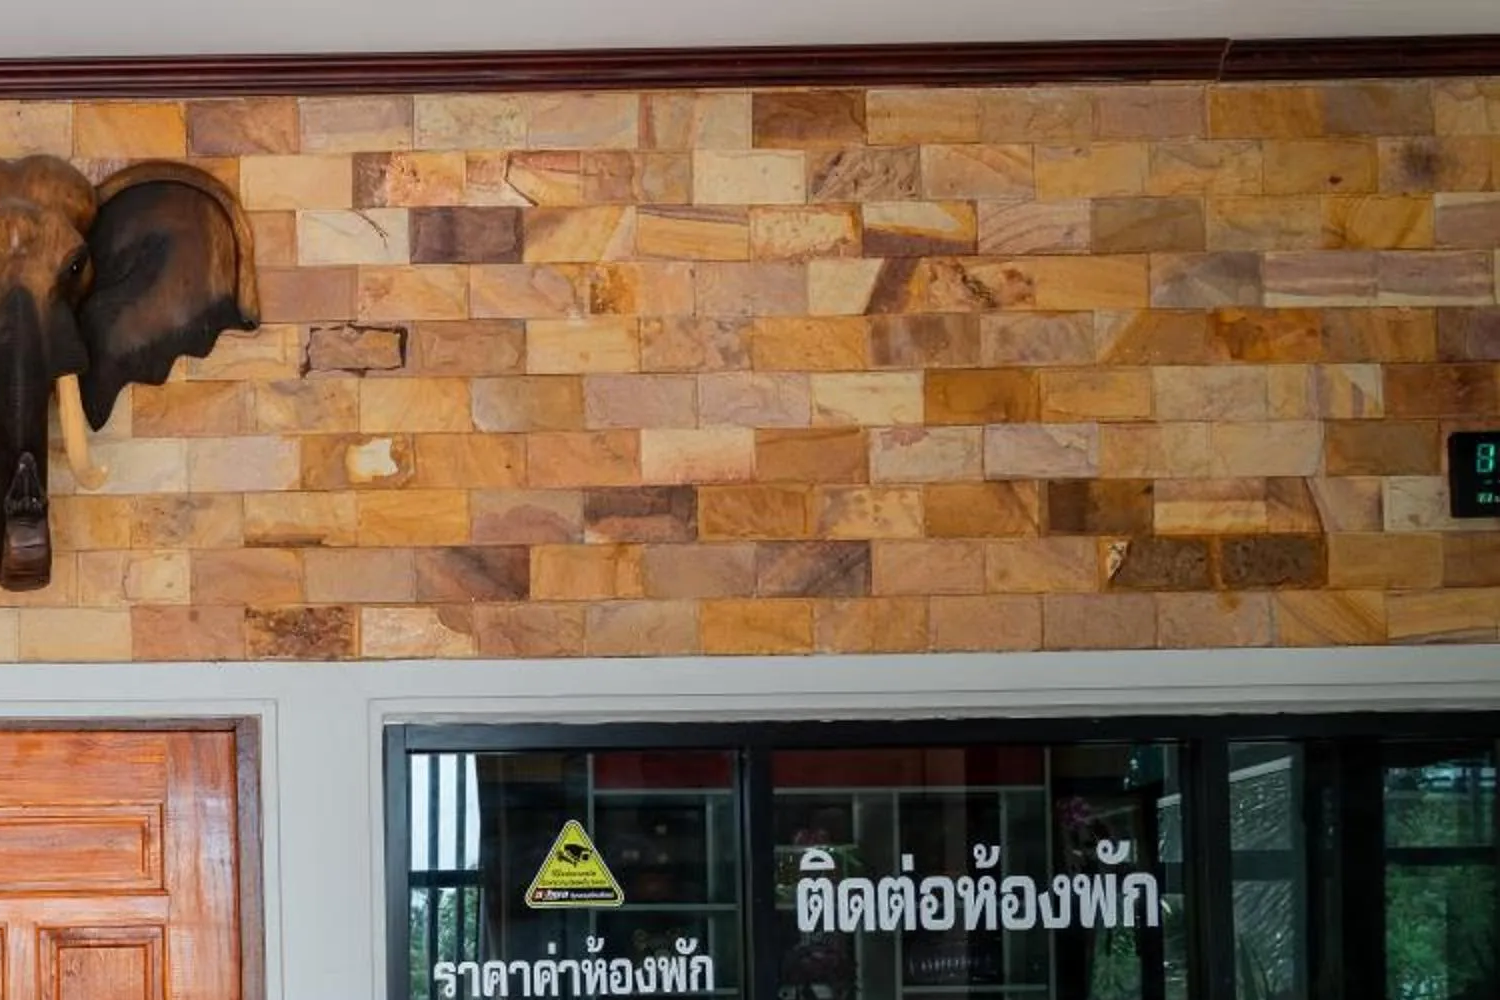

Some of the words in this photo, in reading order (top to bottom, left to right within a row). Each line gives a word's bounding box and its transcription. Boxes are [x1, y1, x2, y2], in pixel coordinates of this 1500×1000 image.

[797, 839, 1160, 931] ติดต่อห้องพัก
[433, 935, 715, 997] ราคาค่าห้องพัก
